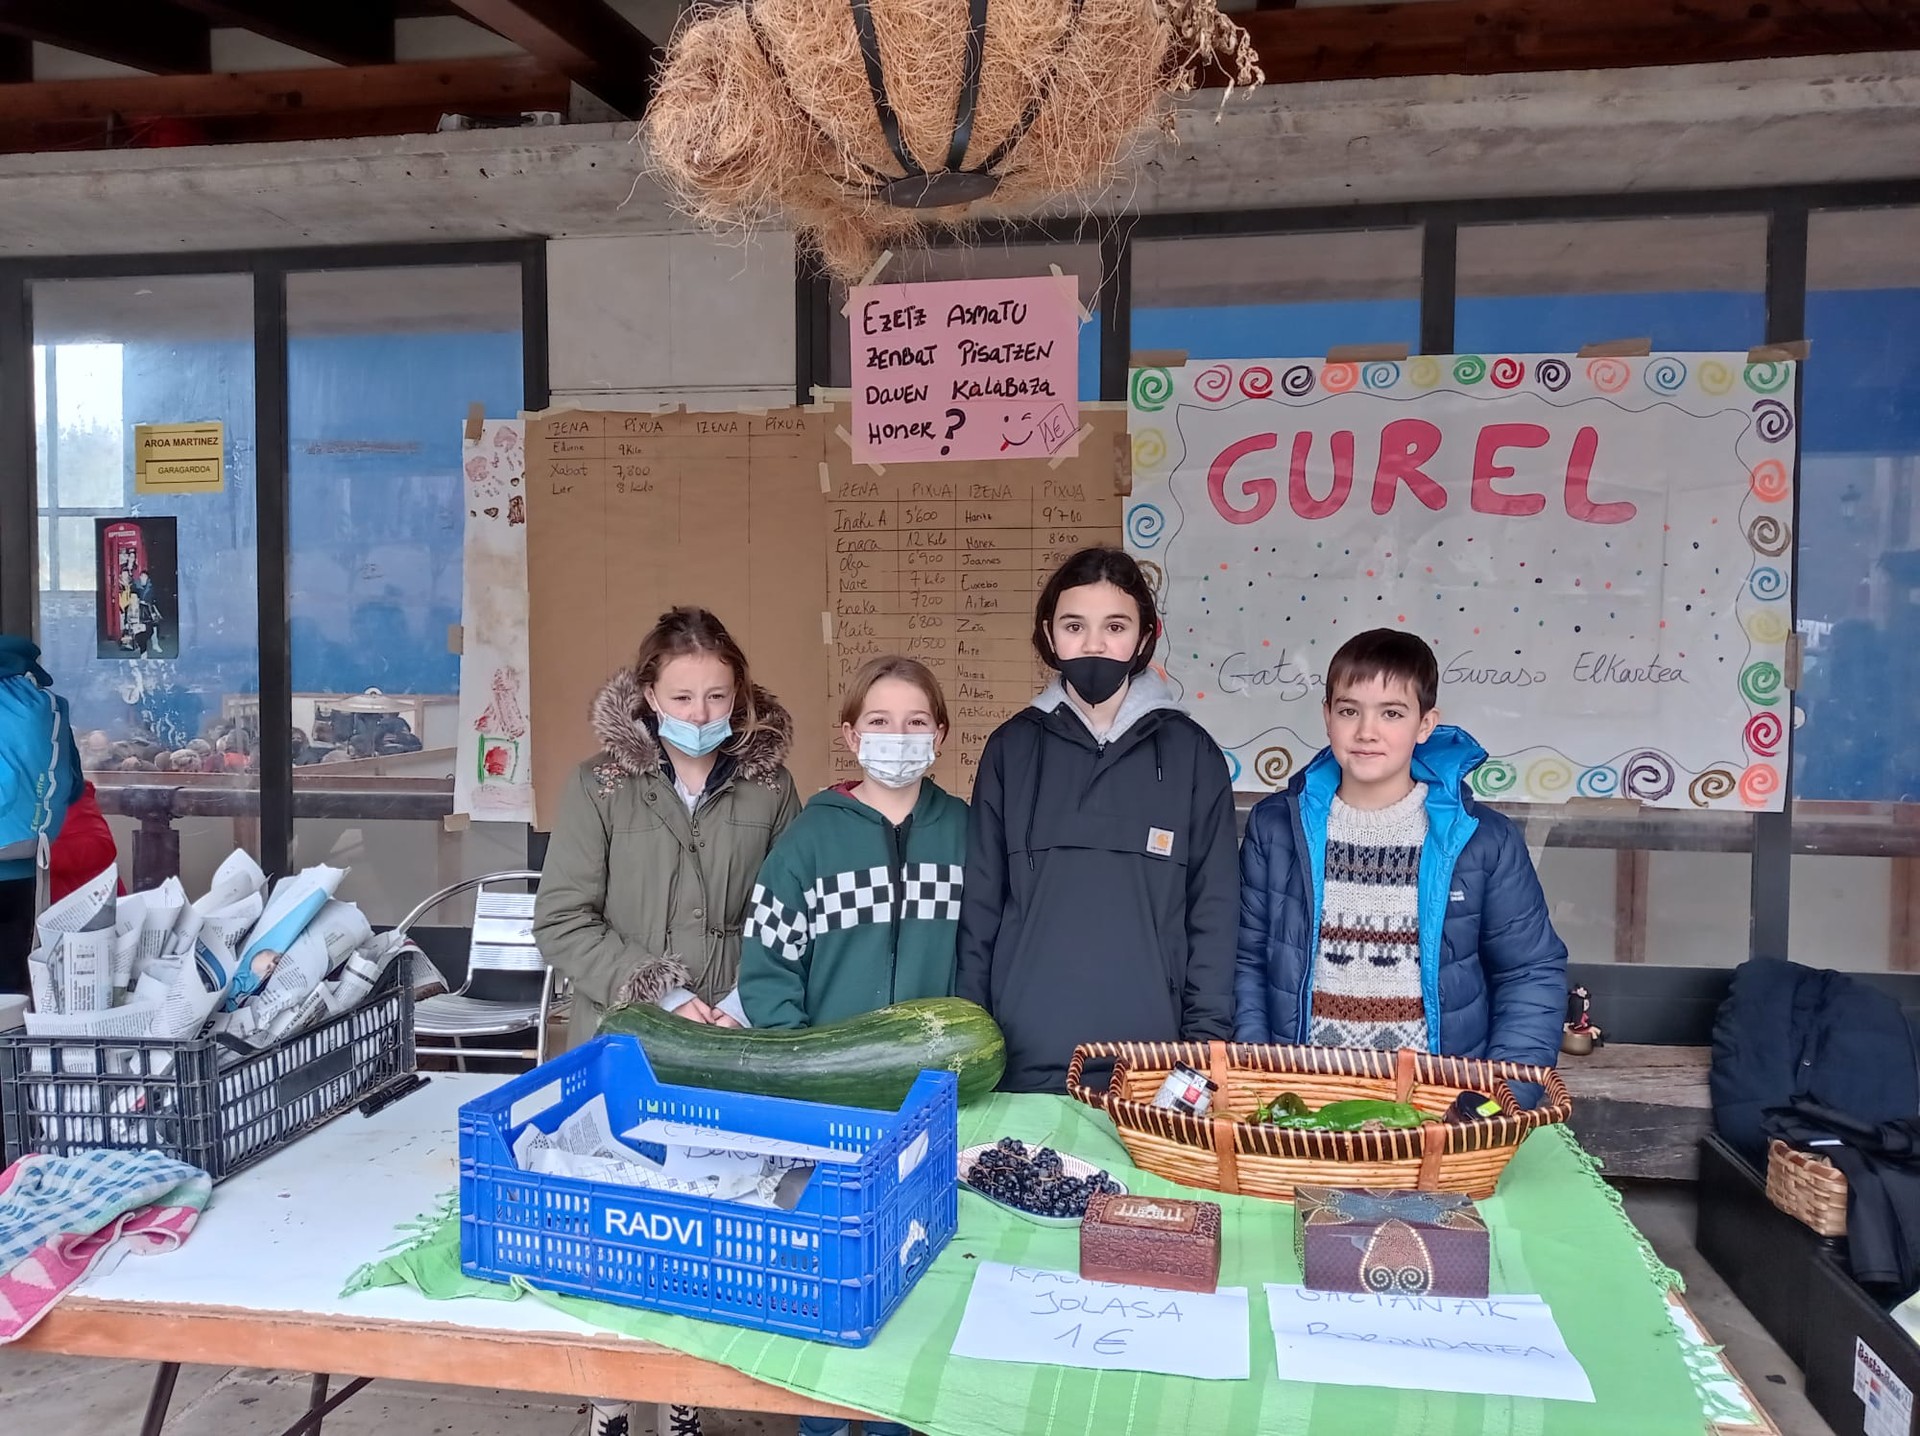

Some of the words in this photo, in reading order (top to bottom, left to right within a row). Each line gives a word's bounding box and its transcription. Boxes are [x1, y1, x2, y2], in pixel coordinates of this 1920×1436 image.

[548, 421, 589, 436] IZENA
[697, 421, 738, 434] IZENA
[144, 438, 171, 448] AROA
[172, 436, 219, 447] MARTINEZ
[158, 466, 211, 474] GARAGARDOA
[1207, 418, 1638, 525] GUREL
[969, 484, 1013, 500] IZENA
[906, 531, 923, 547] 12
[1441, 649, 1547, 687] Guraso
[605, 1207, 703, 1248] RADVI
[1030, 1291, 1184, 1322] JOLASA
